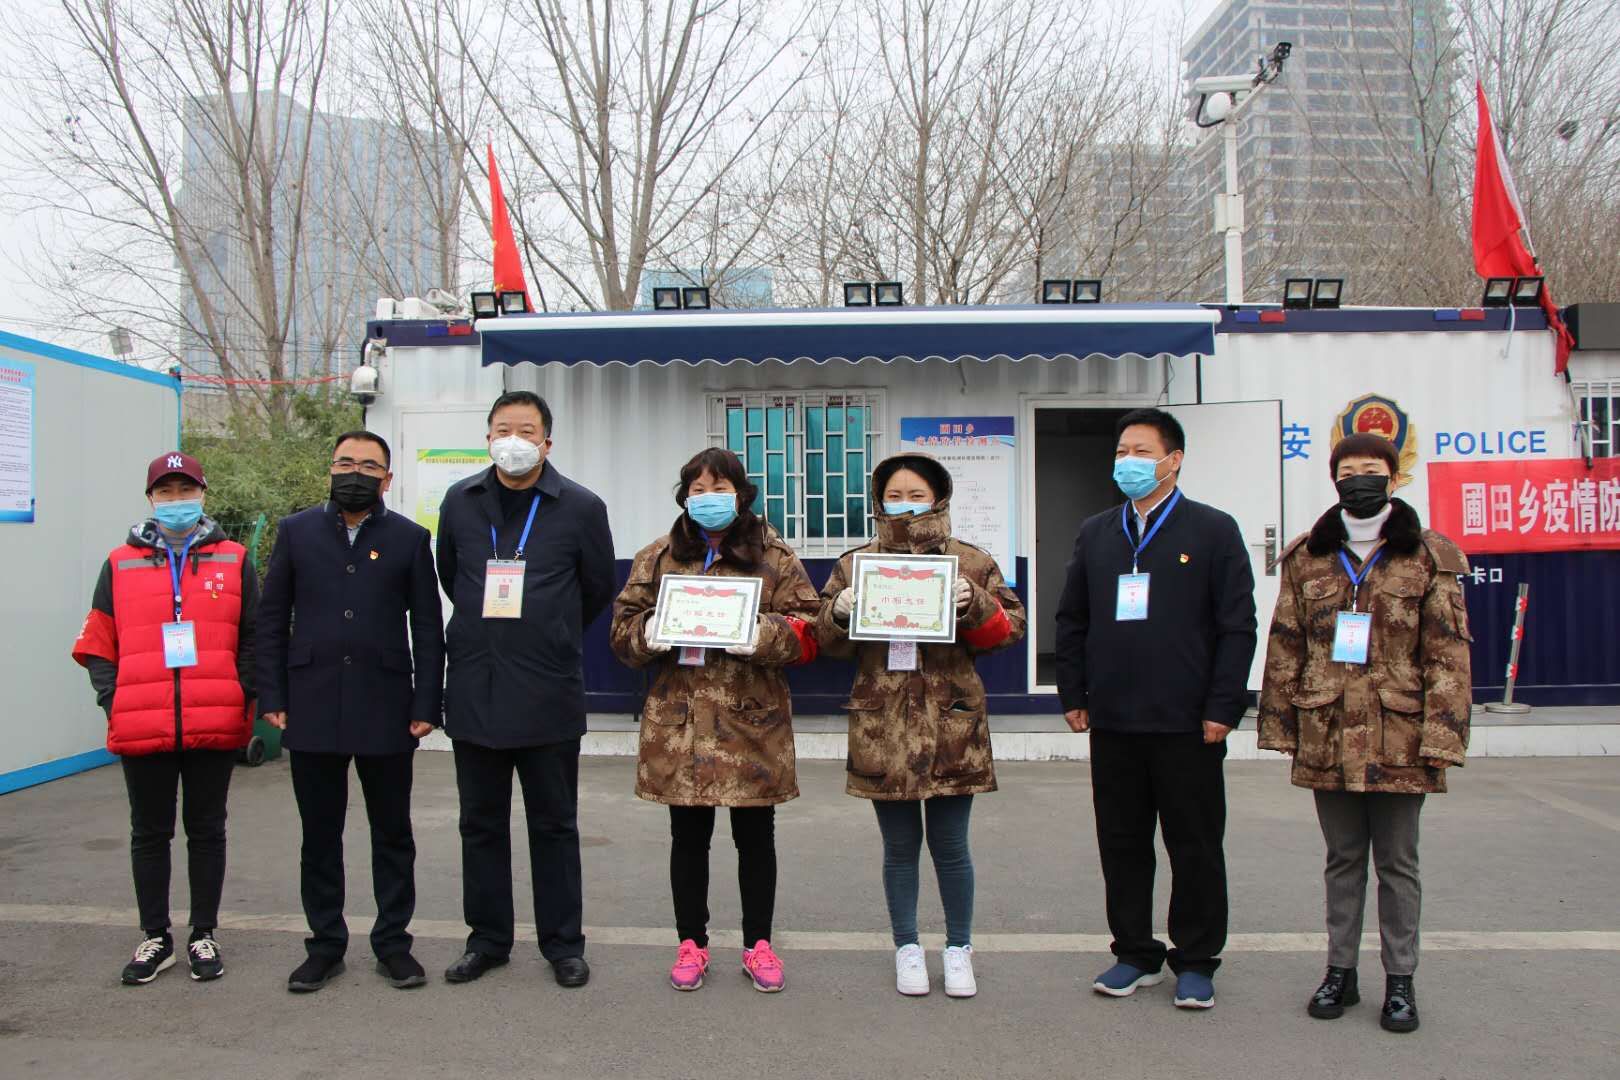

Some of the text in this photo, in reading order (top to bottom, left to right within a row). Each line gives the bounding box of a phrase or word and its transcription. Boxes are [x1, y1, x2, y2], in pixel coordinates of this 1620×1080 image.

[1282, 423, 1311, 459] 安
[1435, 430, 1547, 455] POLICE
[167, 455, 183, 468] NY
